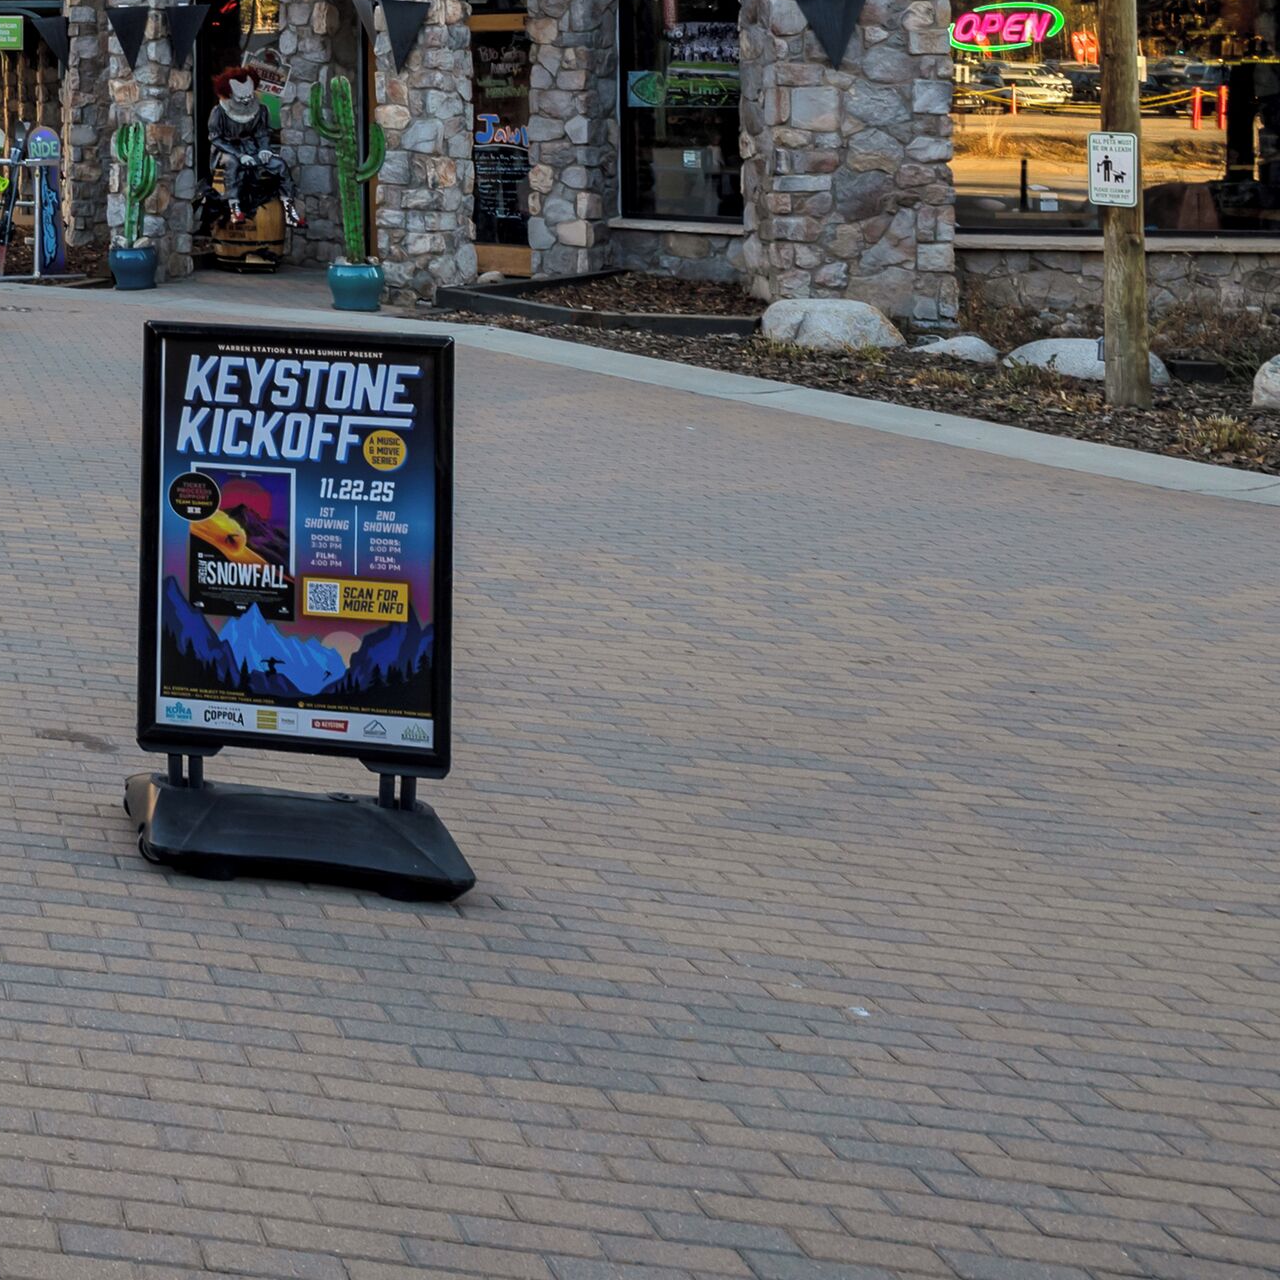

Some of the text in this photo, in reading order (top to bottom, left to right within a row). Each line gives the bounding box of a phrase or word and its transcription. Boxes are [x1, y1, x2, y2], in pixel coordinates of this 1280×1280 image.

[954, 12, 1052, 42] OPEN
[30, 141, 59, 158] RIDE
[218, 344, 250, 352] WARREN
[253, 346, 285, 354] STATION
[349, 351, 383, 359] PRESENT
[184, 354, 422, 414] KEYSTONE
[176, 406, 414, 462] KICKOFF
[369, 436, 400, 446] A MUSIC
[376, 446, 400, 456] MOVIE
[372, 457, 398, 465] SERIES
[320, 478, 395, 502] 11.22.25
[376, 511, 396, 521] 2ND
[305, 518, 349, 530] SHOWING
[363, 521, 408, 534] SHOWING
[311, 534, 342, 542] DOORS:
[370, 538, 400, 546] DOORS:
[207, 560, 288, 588] SNOWFALL
[343, 587, 398, 601] SCAN FOR
[343, 600, 404, 614] MORE INFO
[166, 702, 192, 715] KONA
[204, 710, 244, 726] COPPOLA
[322, 721, 345, 729] KEYSTONE
